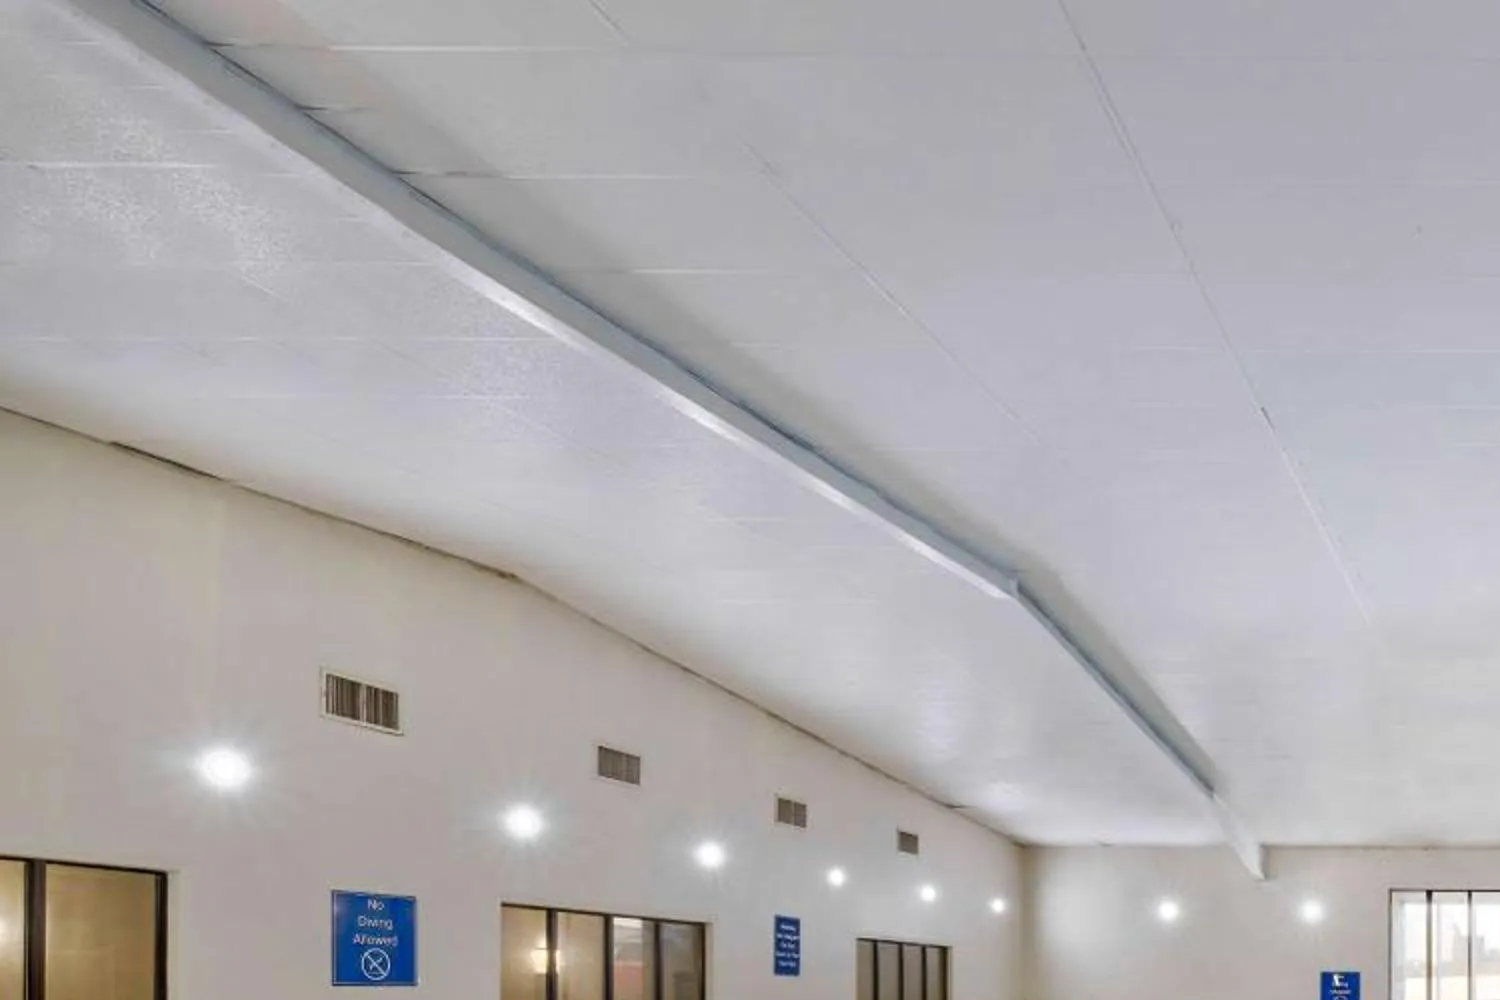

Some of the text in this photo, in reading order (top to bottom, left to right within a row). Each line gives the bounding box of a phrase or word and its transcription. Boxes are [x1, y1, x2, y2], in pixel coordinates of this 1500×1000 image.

[367, 899, 385, 911] No
[357, 915, 394, 931] Diving
[352, 933, 399, 947] Allowed
